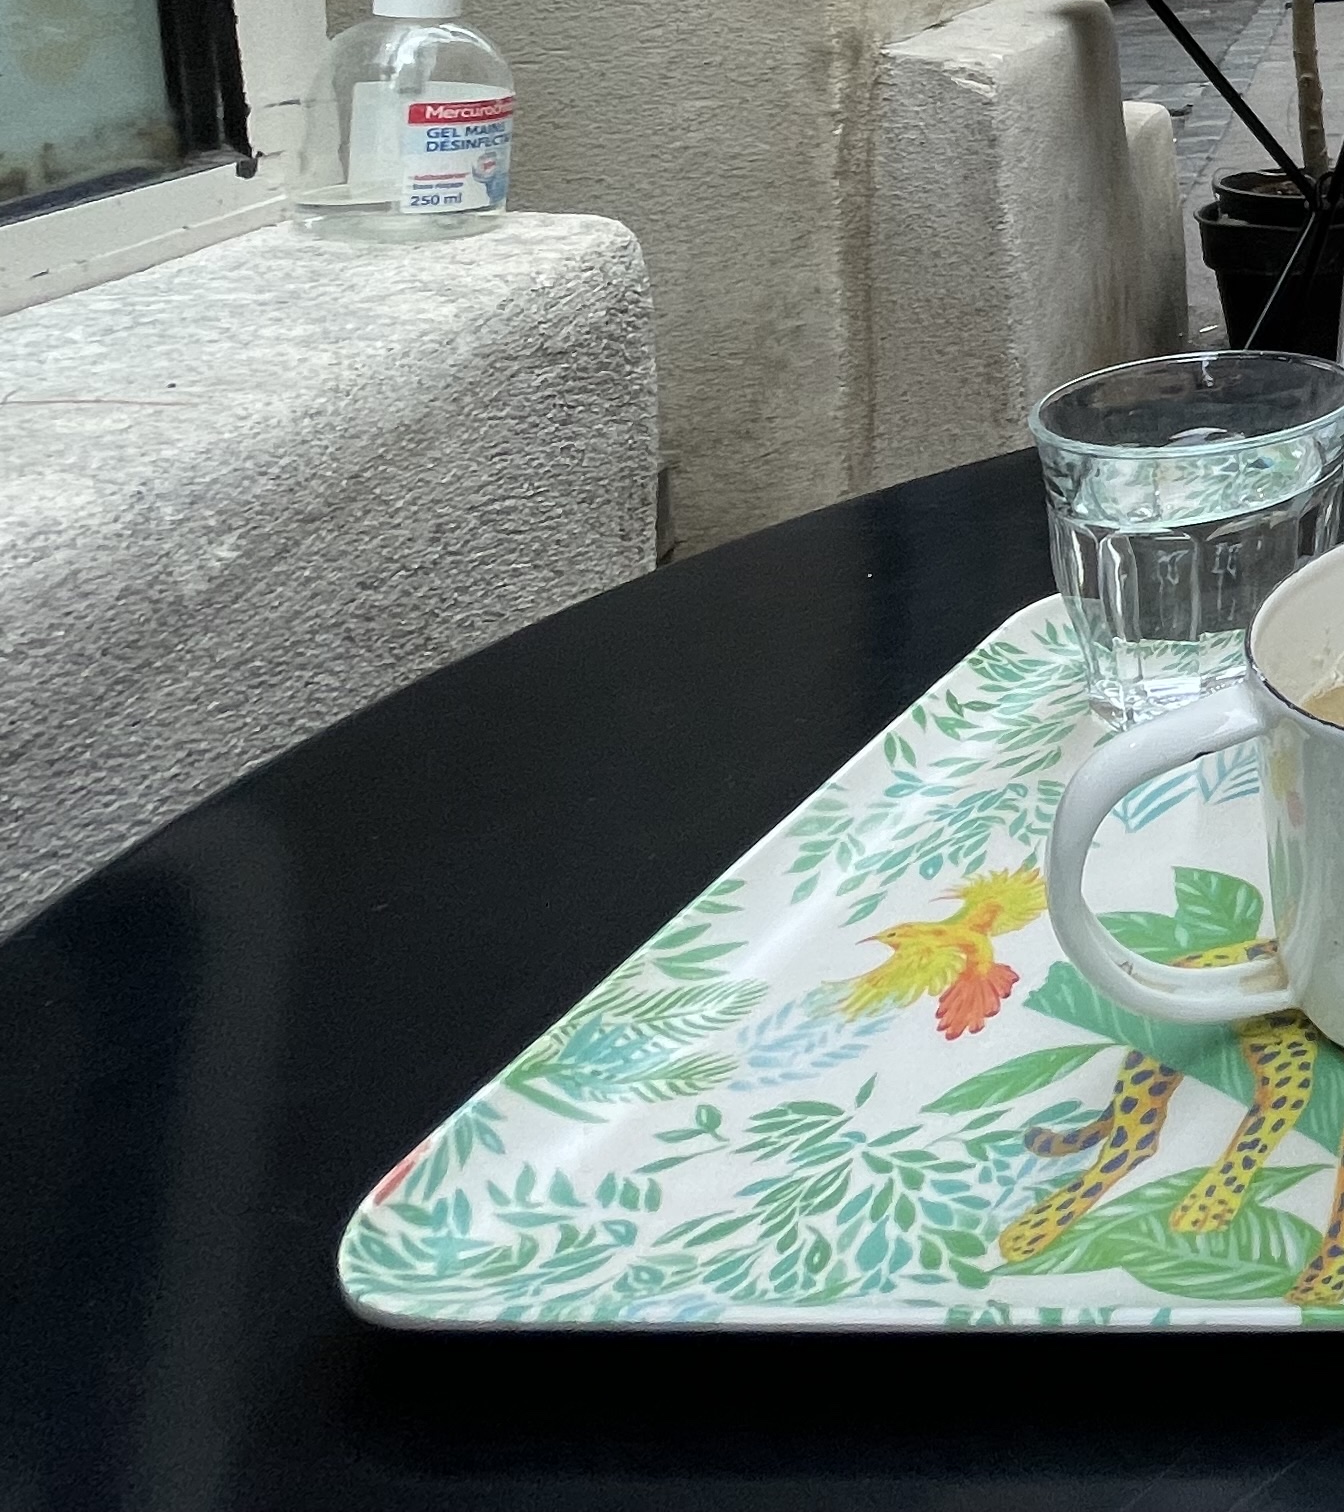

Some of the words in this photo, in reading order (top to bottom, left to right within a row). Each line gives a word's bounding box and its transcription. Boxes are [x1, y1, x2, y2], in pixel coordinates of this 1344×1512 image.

[426, 127, 461, 139] GEL
[410, 194, 440, 206] 250
[444, 192, 462, 204] ml
